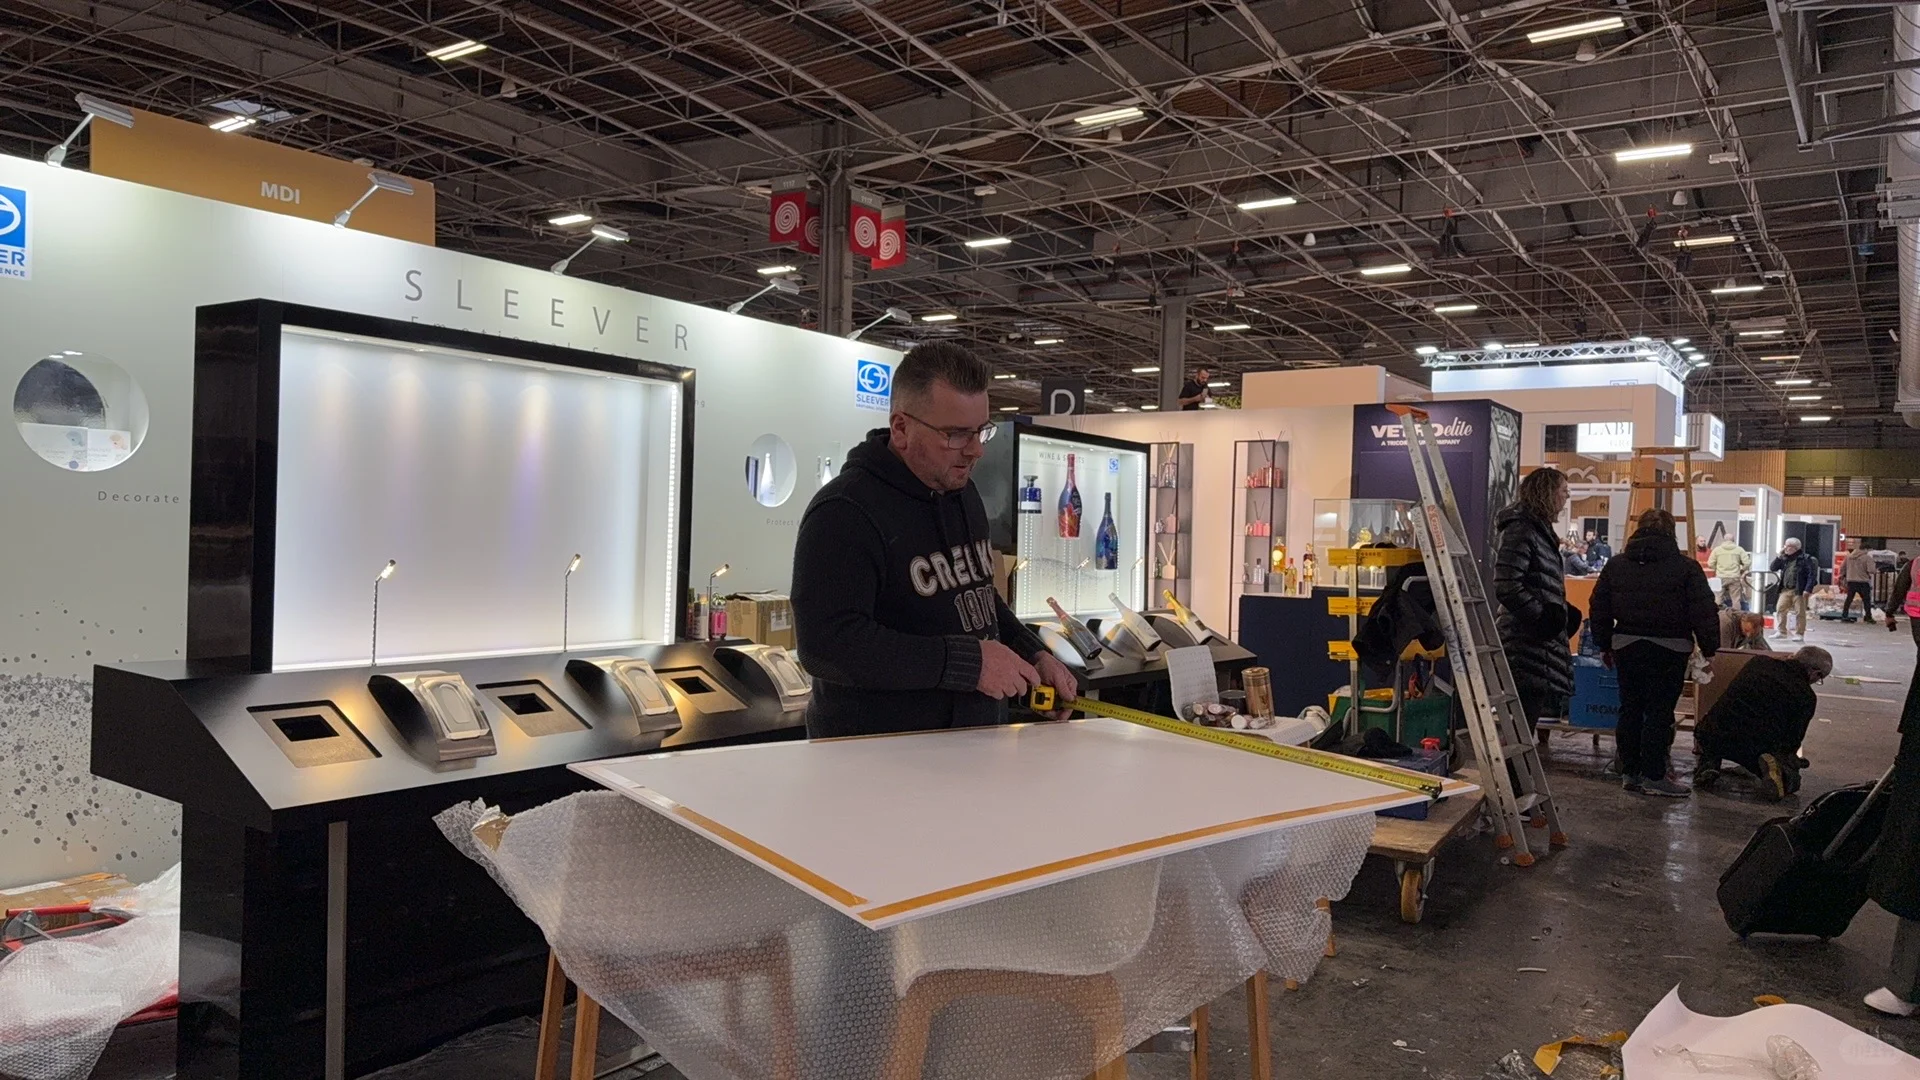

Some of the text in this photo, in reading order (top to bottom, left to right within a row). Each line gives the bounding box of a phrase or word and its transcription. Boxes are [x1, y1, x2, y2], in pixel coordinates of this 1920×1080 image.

[261, 180, 300, 205] MDI
[404, 269, 689, 351] SLEEVER
[856, 393, 890, 407] SLEEVER
[97, 490, 180, 504] Decorate
